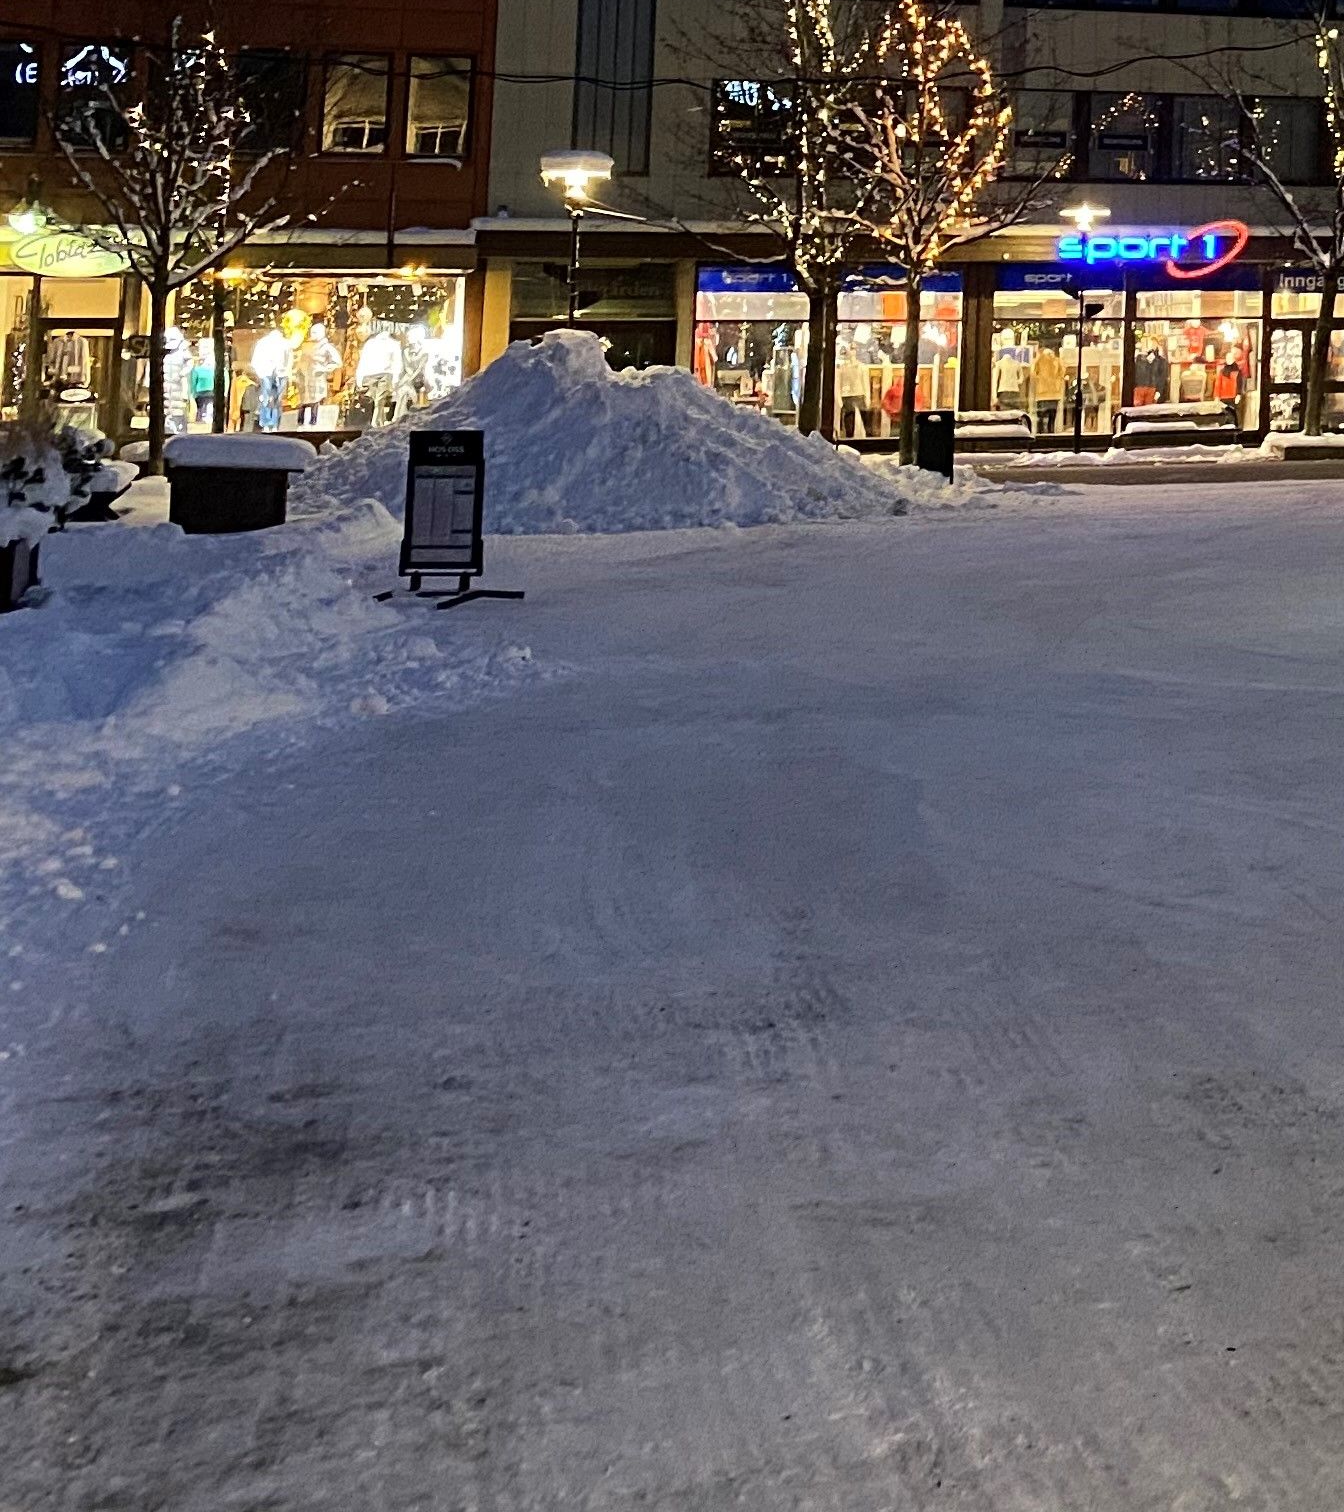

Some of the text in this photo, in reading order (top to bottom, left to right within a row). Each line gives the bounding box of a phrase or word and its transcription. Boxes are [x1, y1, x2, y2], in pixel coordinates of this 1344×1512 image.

[1059, 234, 1217, 265] sport 1
[1024, 273, 1073, 284] sport
